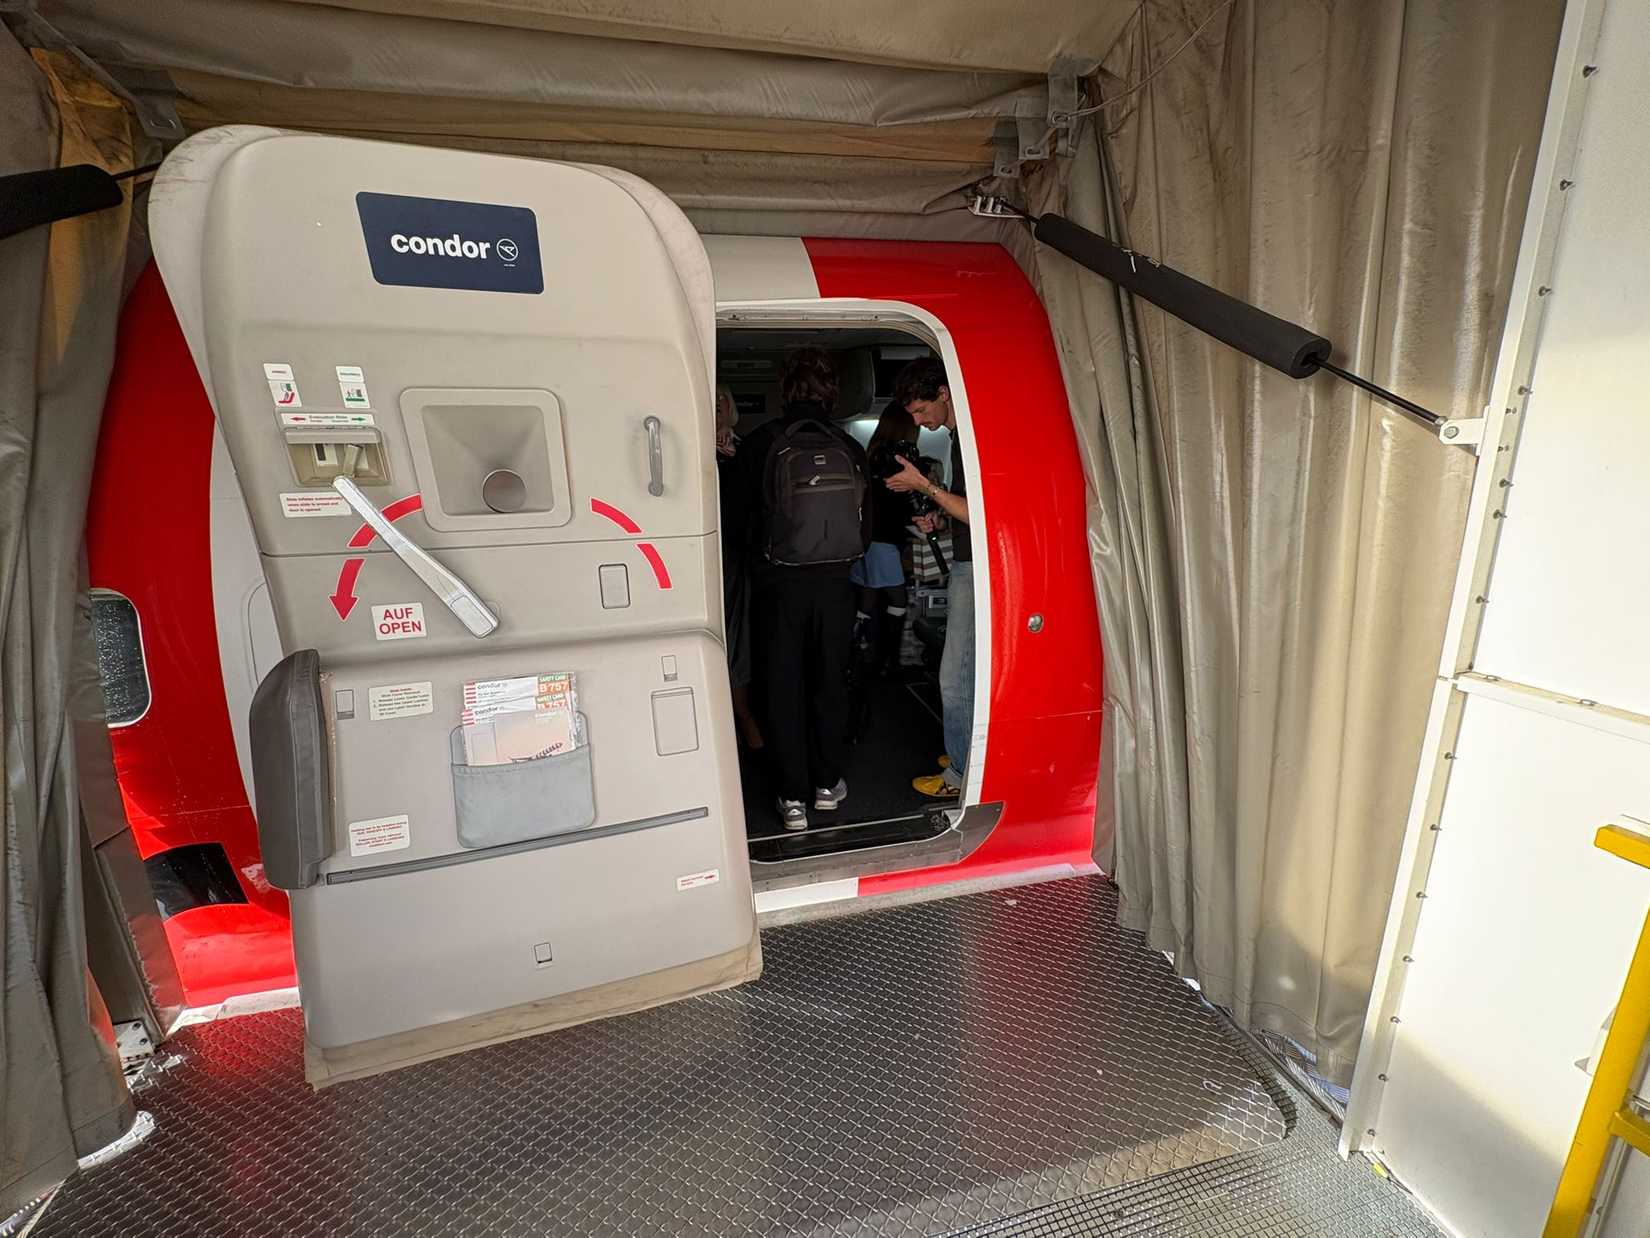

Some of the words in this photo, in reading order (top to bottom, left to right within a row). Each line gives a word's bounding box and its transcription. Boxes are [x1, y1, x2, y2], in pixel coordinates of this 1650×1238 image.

[390, 233, 491, 259] condor
[383, 607, 413, 621] AUF
[379, 620, 422, 635] OPEN
